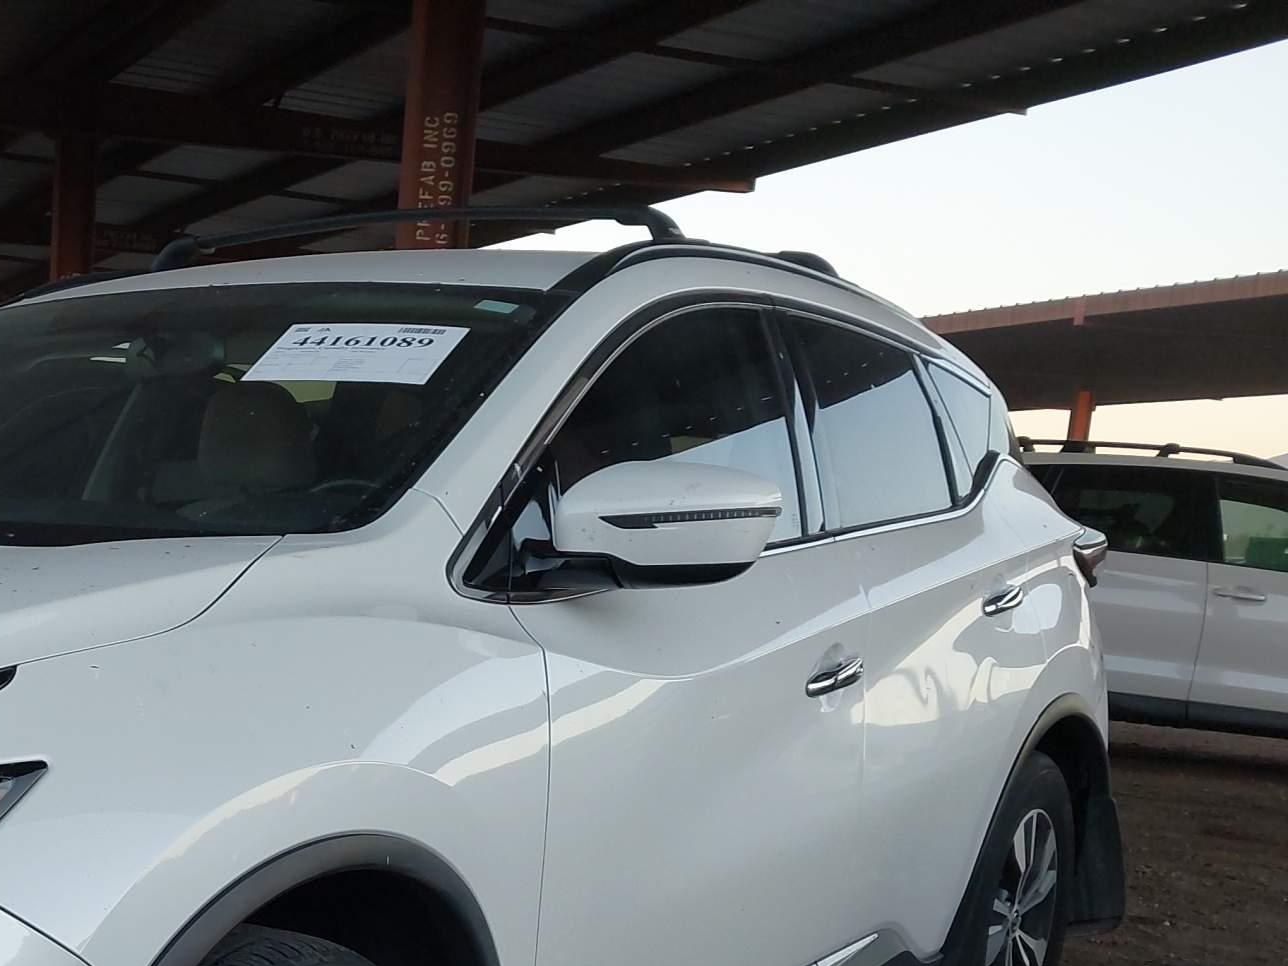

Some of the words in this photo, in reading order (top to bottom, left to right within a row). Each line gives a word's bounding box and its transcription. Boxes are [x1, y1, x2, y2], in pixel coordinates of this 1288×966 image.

[421, 115, 440, 149] INC
[434, 112, 459, 245] 6-99-0969
[291, 335, 435, 349] 44161089
